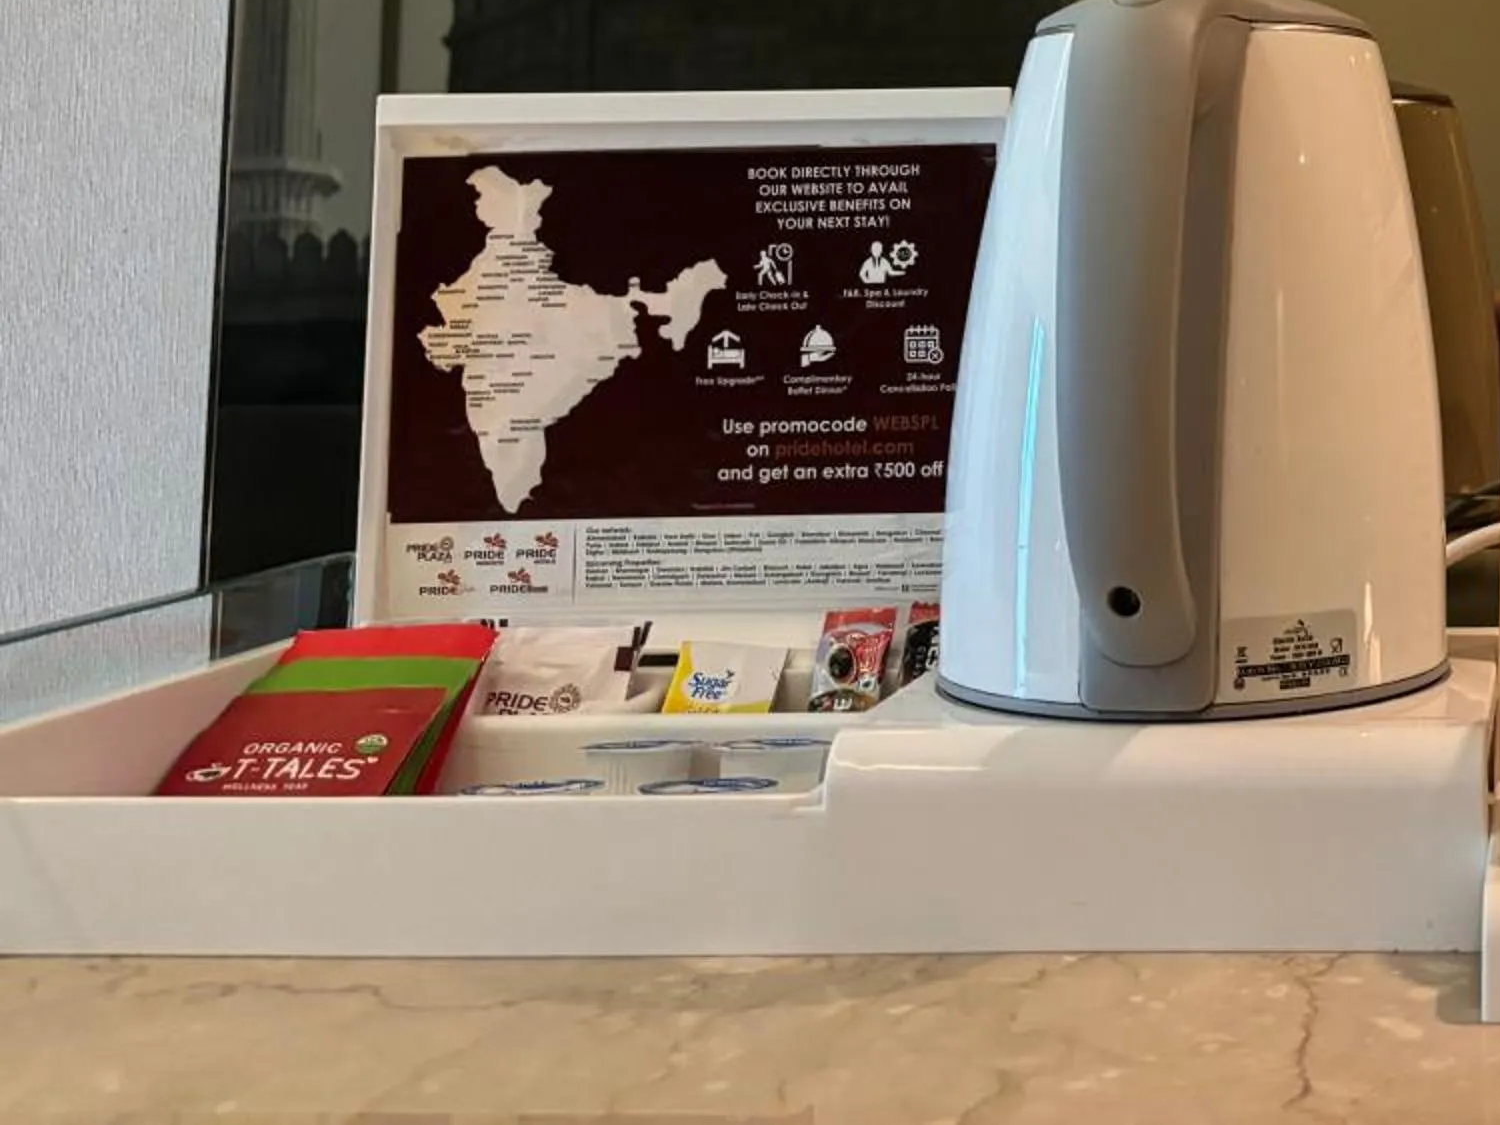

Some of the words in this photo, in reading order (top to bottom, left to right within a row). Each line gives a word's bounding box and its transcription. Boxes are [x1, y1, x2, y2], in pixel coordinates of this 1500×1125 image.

[748, 168, 787, 180] BOOK
[791, 166, 851, 179] DIRECTLY
[855, 164, 920, 177] THROUGH
[759, 184, 786, 196] OUR
[791, 183, 843, 195] WEBSITE
[847, 182, 863, 195] TO
[867, 181, 908, 194] AVAIL
[755, 200, 825, 213] EXCLUSIVE
[829, 199, 885, 212] BENEFITS
[889, 198, 911, 210] ON
[777, 218, 814, 230] YOUR
[817, 217, 850, 229] NEXT
[854, 216, 890, 228] STAY!
[723, 418, 755, 434] Use
[759, 416, 868, 437] promocode
[873, 415, 939, 431] WEBSPL
[747, 445, 770, 457] on
[775, 440, 915, 460] pridehotel.com
[717, 465, 753, 481] and
[759, 465, 789, 483] get
[793, 467, 818, 480] an
[823, 464, 869, 479] extra
[874, 462, 915, 478] ₹500
[920, 461, 944, 476] off
[417, 551, 453, 561] PLAZA
[464, 550, 505, 560] PRIDE
[516, 548, 557, 559] PRIDE
[419, 586, 459, 596] PRIDE
[689, 671, 731, 692] Sugar
[691, 685, 724, 700] Free
[486, 691, 548, 711] PRIDE
[243, 742, 343, 755] ORGANIC
[233, 757, 367, 780] T-TALES
